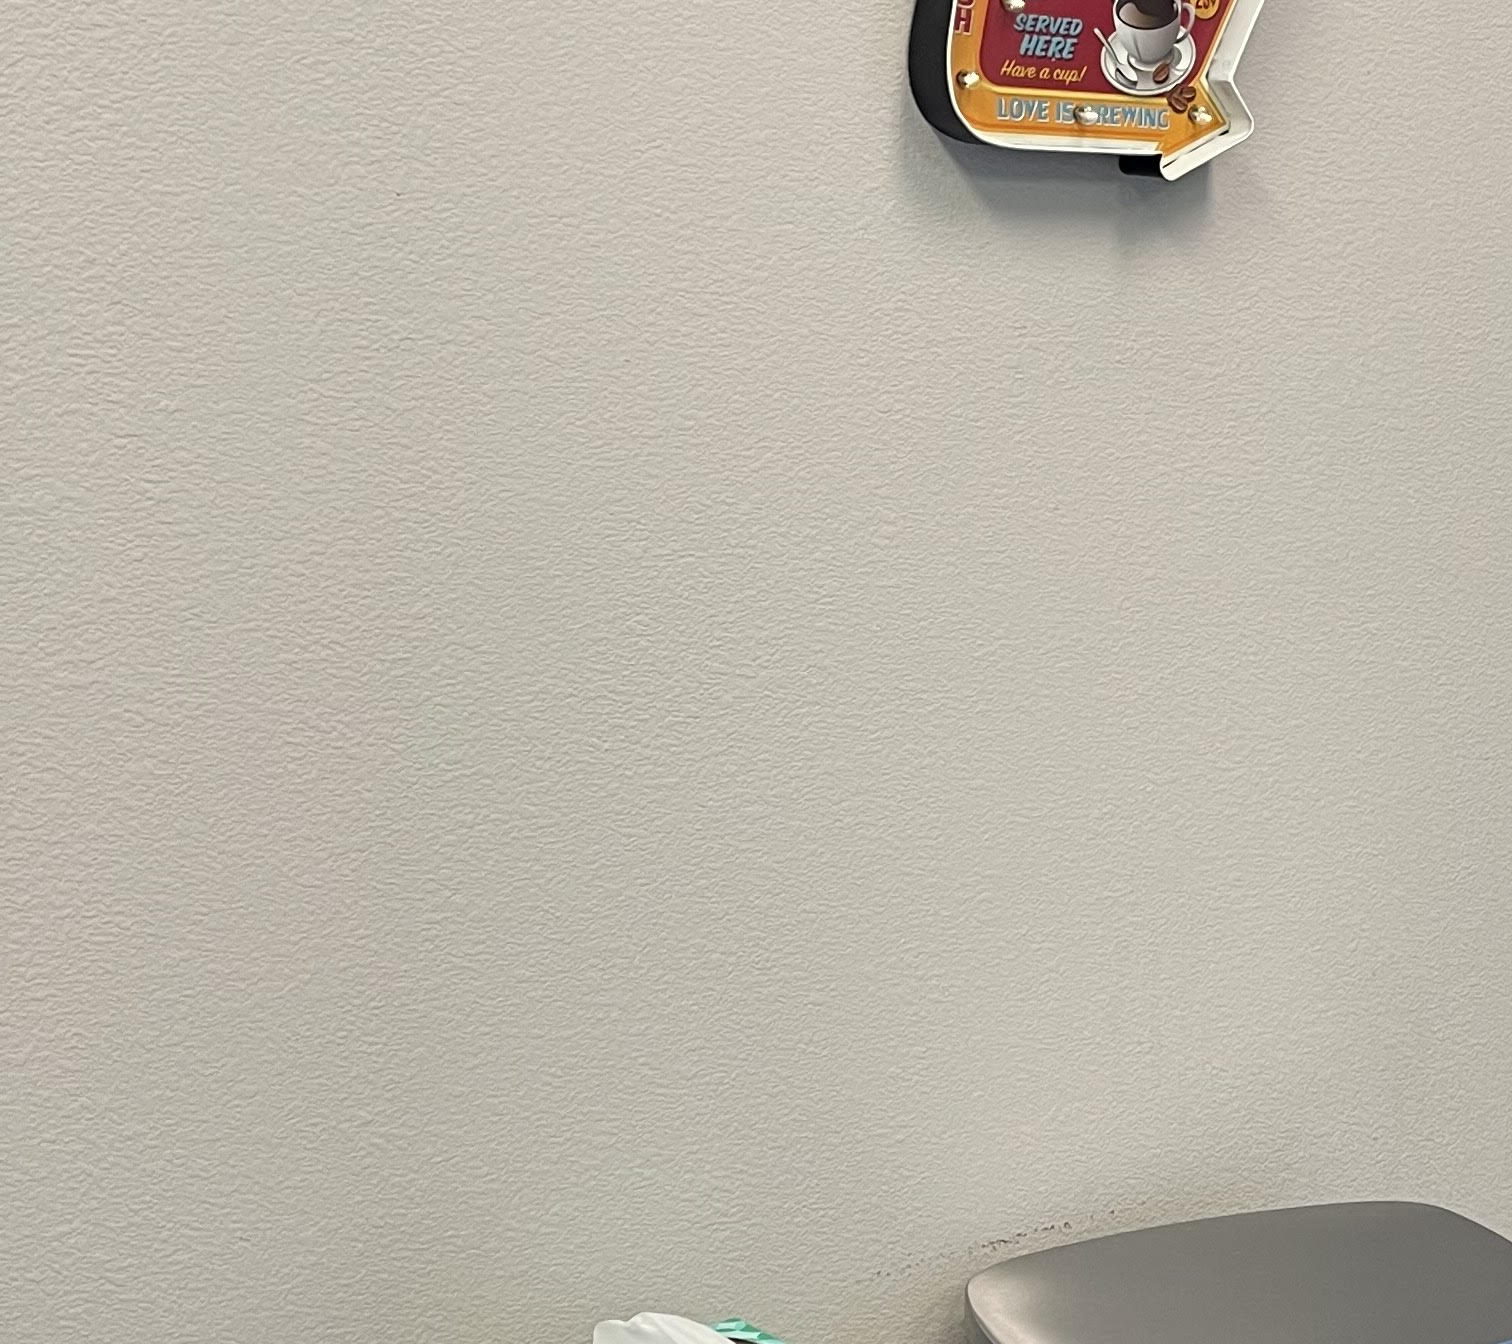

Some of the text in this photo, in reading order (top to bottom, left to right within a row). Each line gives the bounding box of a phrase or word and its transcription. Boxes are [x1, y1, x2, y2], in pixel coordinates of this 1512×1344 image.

[1013, 12, 1084, 36] SERVED
[1019, 34, 1079, 60] HERE
[1000, 59, 1088, 86] Have a cup!
[996, 96, 1171, 131] LOVE IS REWING
